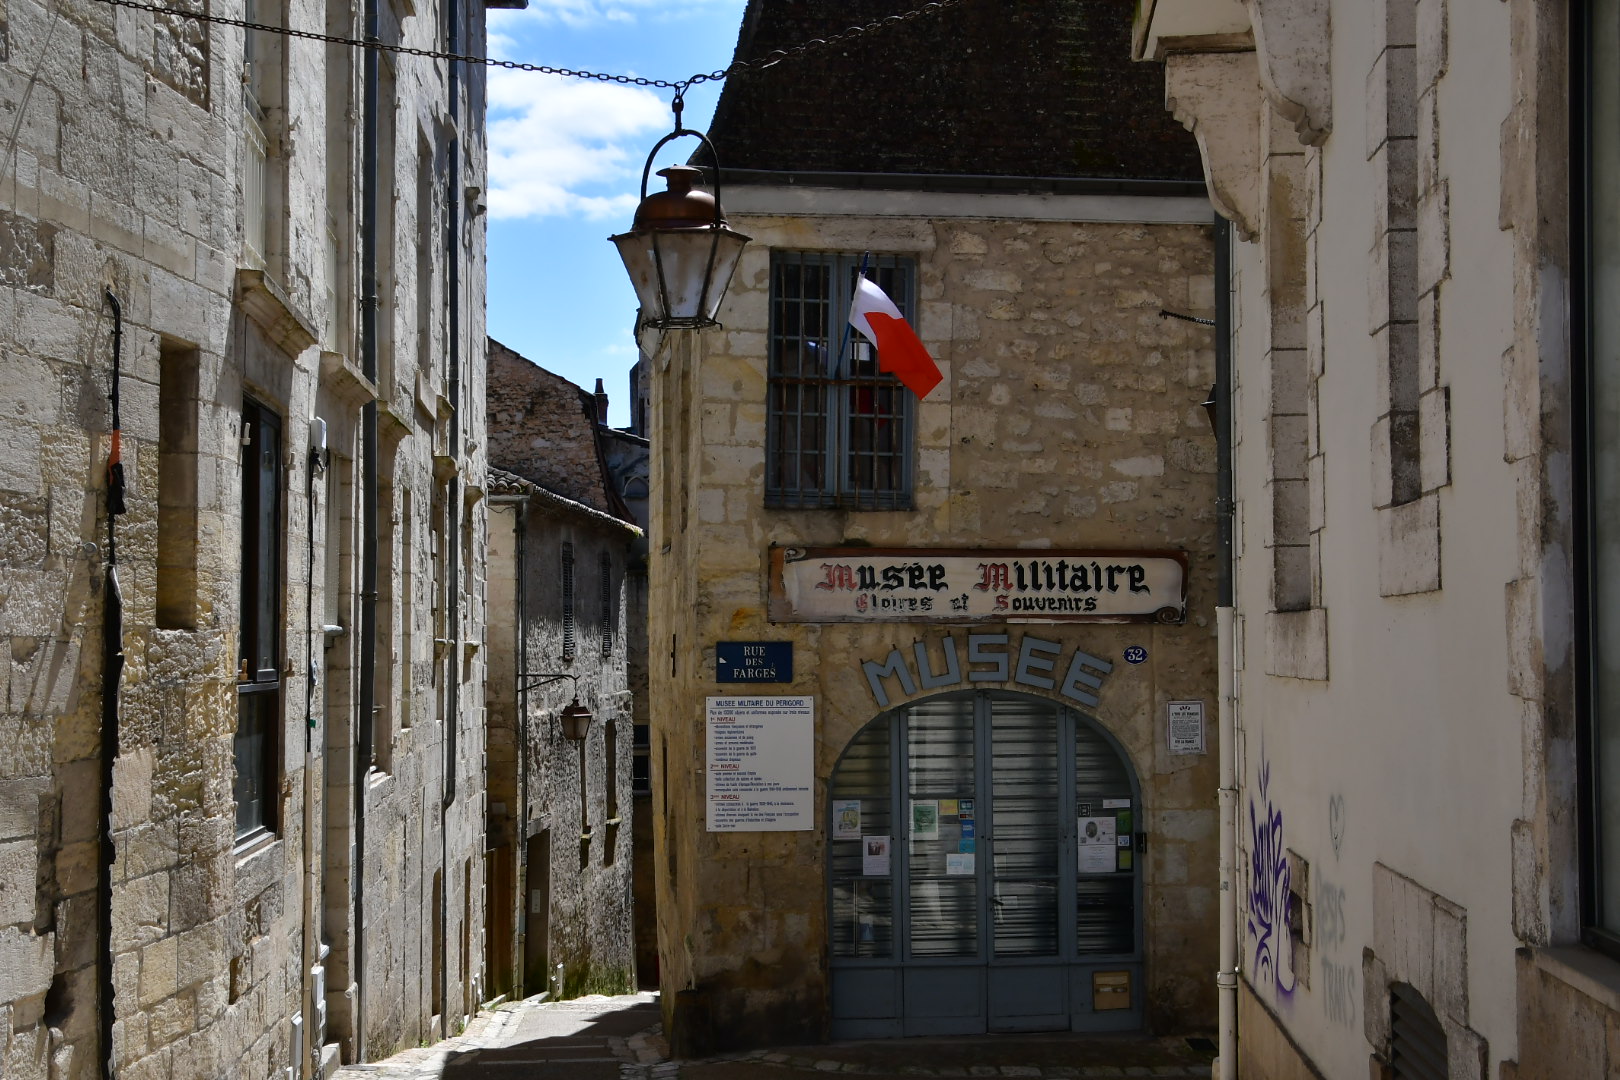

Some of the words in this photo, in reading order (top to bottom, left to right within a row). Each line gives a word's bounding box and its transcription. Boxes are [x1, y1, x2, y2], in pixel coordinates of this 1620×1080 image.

[814, 561, 949, 592] Musée
[973, 559, 1151, 595] Militaire
[992, 594, 1097, 613] Souvenirs
[744, 646, 766, 656] RUE
[1127, 648, 1143, 661] 32
[745, 657, 763, 666] DES
[733, 668, 776, 678] FARGES
[861, 633, 1113, 707] MUSEE
